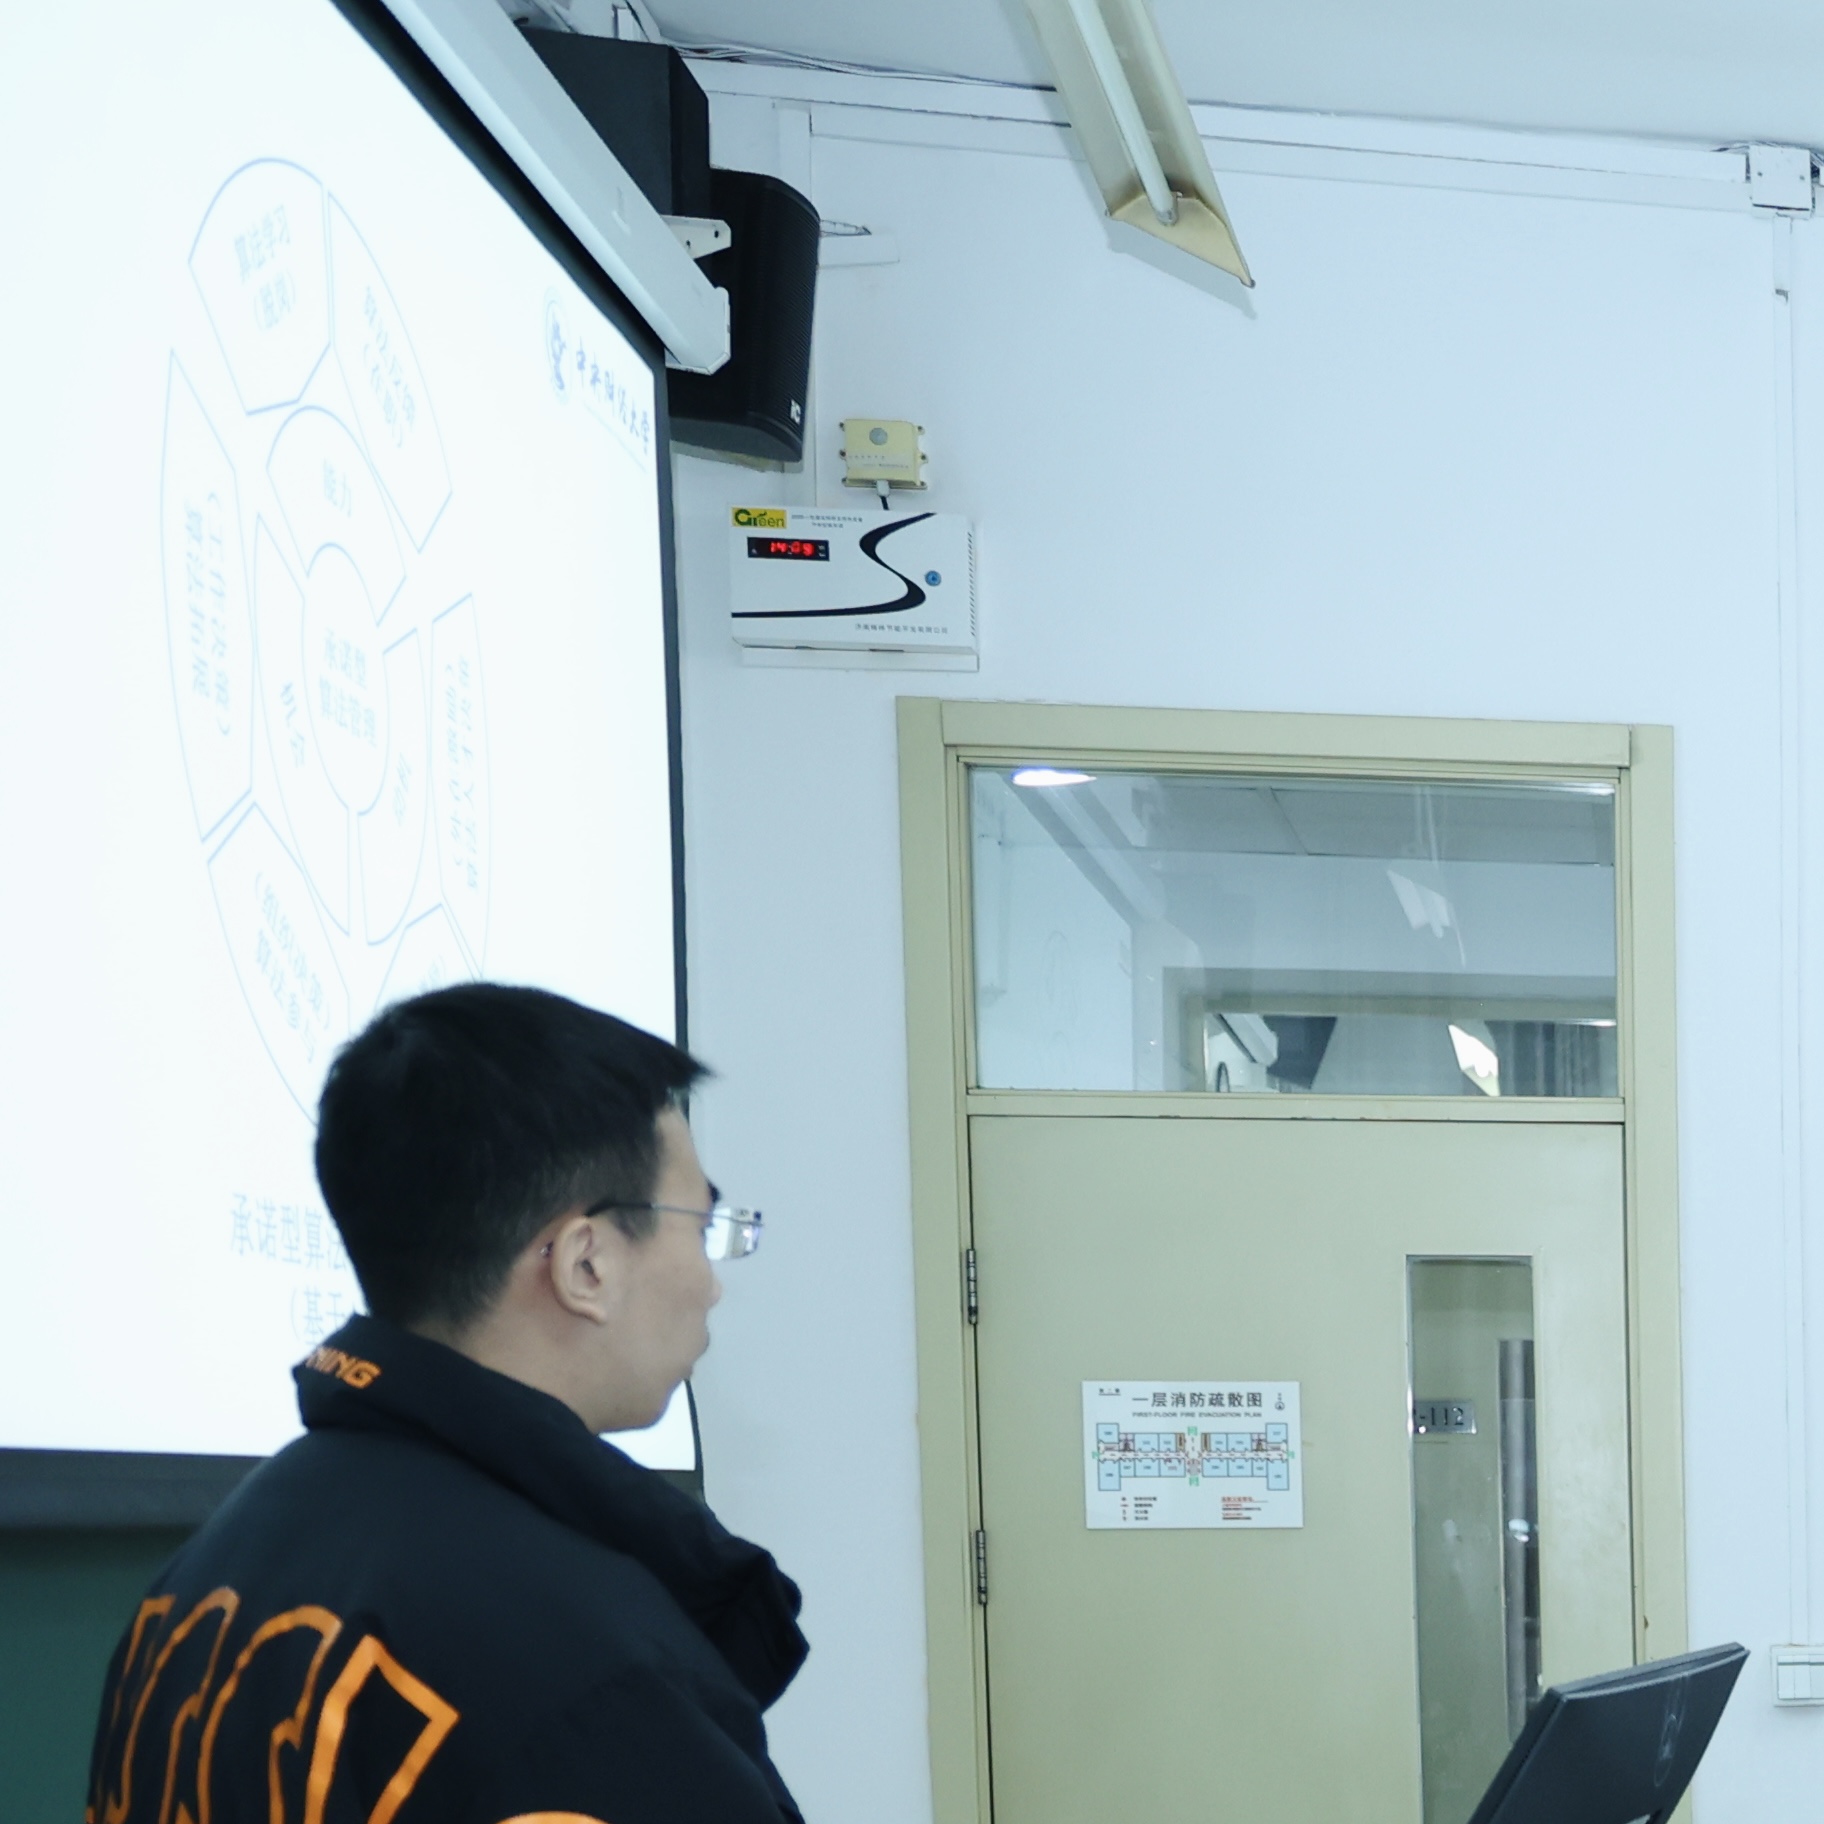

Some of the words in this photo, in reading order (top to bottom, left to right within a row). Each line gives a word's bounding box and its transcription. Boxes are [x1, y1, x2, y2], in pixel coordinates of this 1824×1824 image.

[1131, 1391, 1263, 1408] 一层消防疏散图
